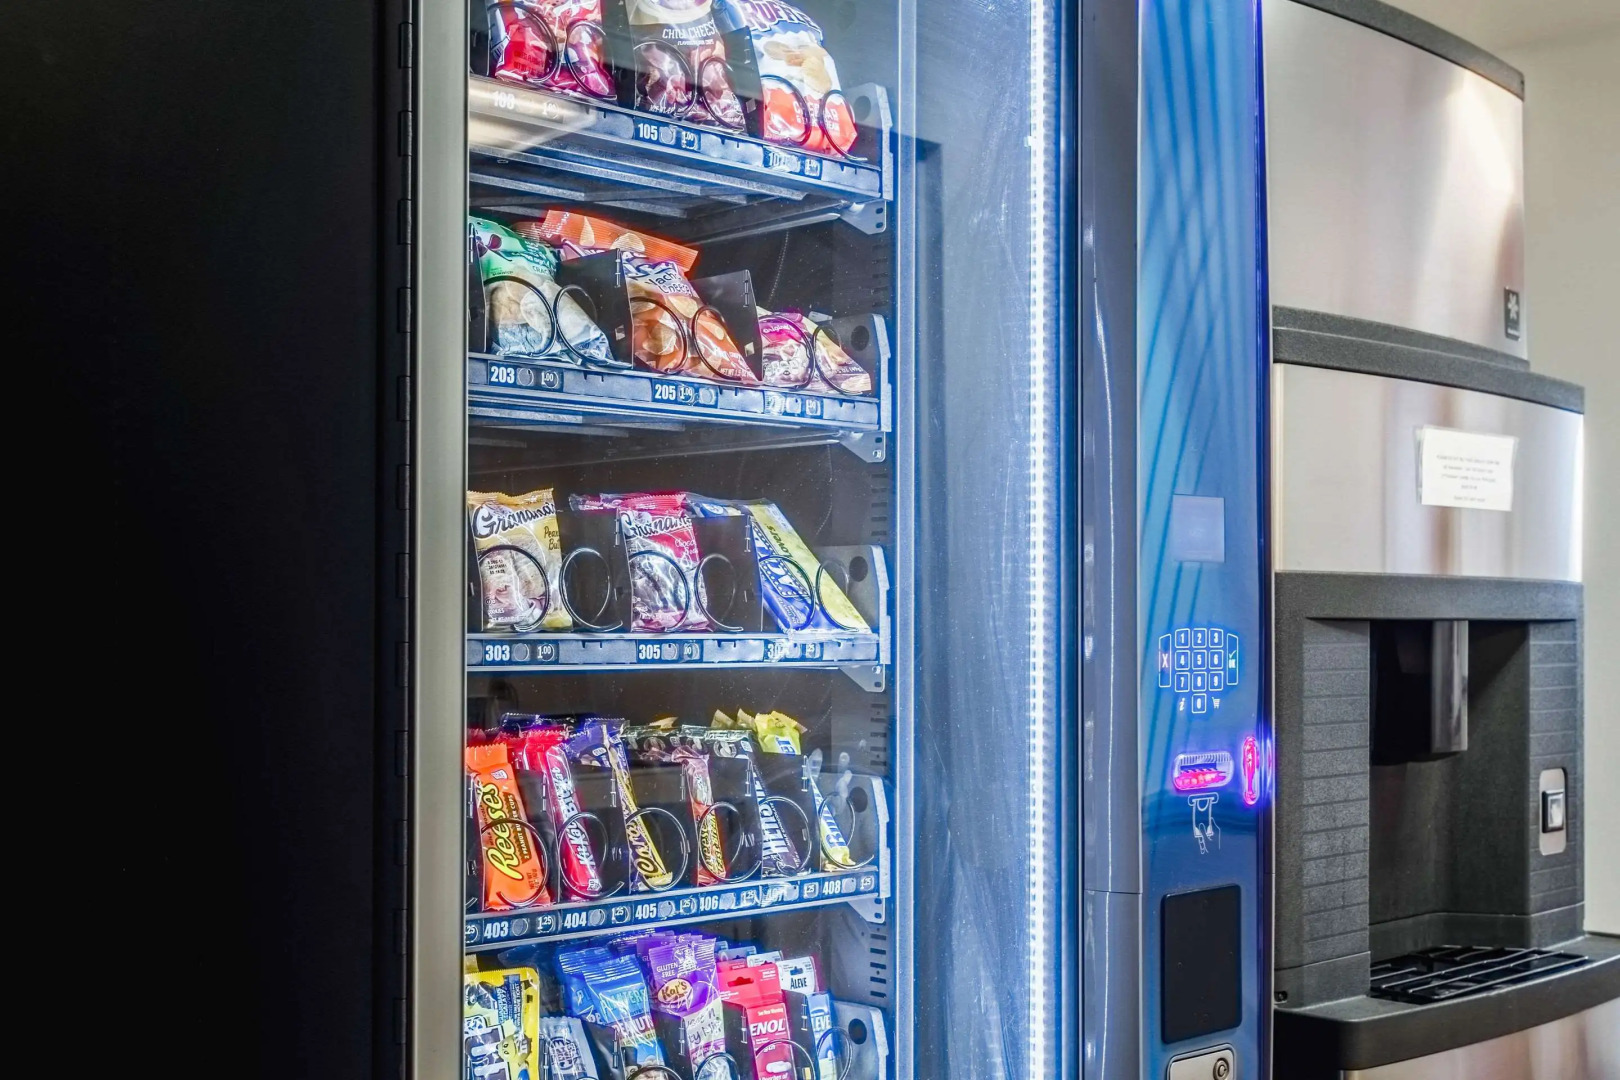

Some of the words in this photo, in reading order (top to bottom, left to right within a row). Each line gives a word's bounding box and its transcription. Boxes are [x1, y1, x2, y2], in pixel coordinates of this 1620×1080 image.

[638, 123, 658, 140] 105
[490, 366, 515, 384] 203
[655, 384, 676, 400] 205
[1180, 633, 1185, 643] 1
[1197, 633, 1202, 643] 2
[1213, 633, 1218, 643] 3
[485, 645, 510, 662] 303
[639, 644, 660, 660] 305
[1180, 655, 1185, 666] 4
[1197, 655, 1202, 665] 5
[1213, 655, 1218, 665] 6
[1229, 659, 1236, 669] OK
[1180, 677, 1185, 687] 7
[1197, 677, 1202, 687] 8
[1213, 676, 1218, 686] 9
[1196, 697, 1201, 709] 0
[508, 794, 517, 812] CUPS
[520, 832, 529, 855] PEANUT
[823, 879, 841, 895] 408
[635, 902, 657, 919] 405
[699, 895, 718, 911] 406
[484, 921, 508, 939] 403
[537, 915, 552, 932] 1.25
[564, 911, 587, 929] 404
[657, 962, 678, 973] GLUTEN
[662, 970, 676, 978] FREE
[790, 977, 807, 990] ALEVE
[750, 1018, 786, 1036] ENOL
[811, 1014, 831, 1032] LEVE
